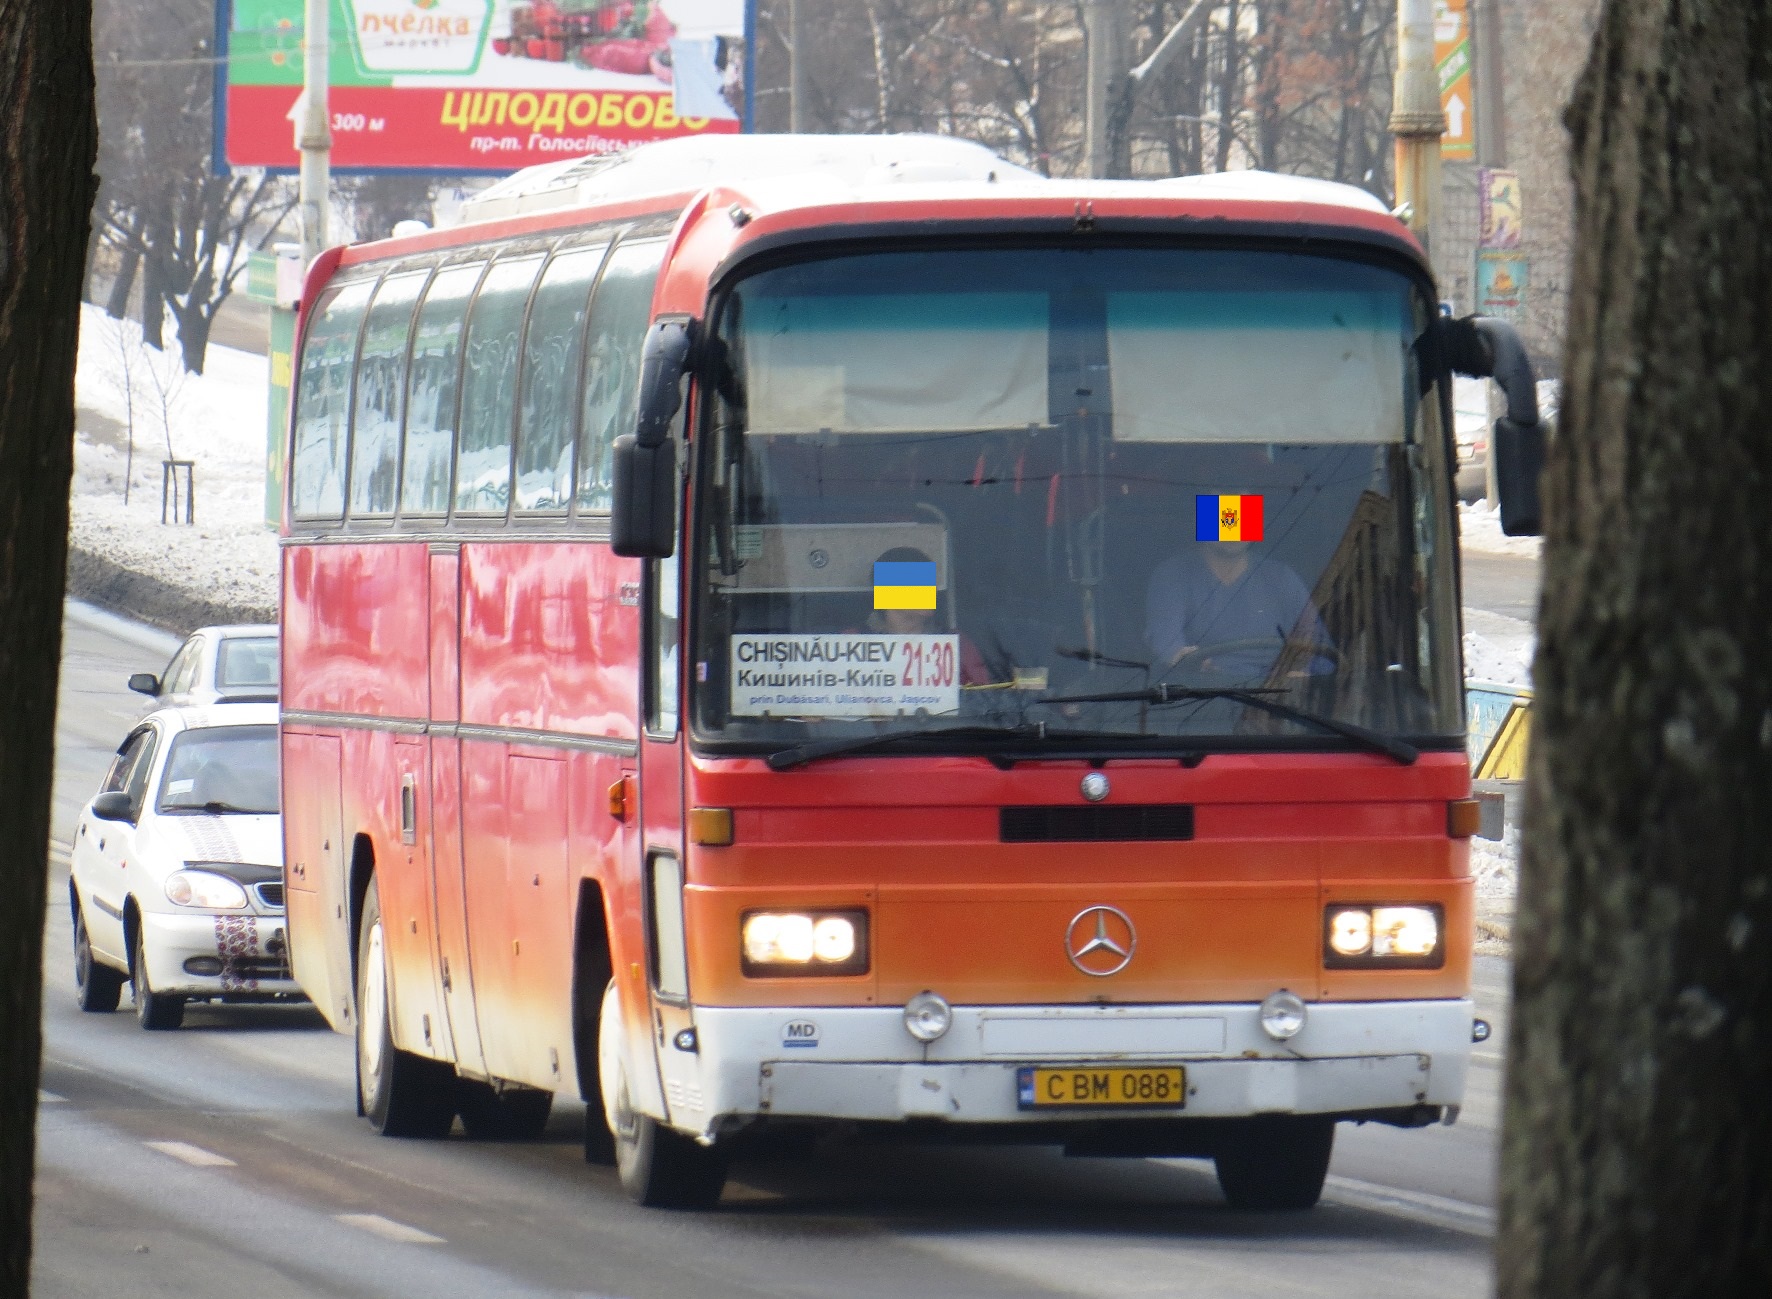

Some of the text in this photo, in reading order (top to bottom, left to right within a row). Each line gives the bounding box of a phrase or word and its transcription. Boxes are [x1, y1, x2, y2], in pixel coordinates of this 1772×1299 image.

[331, 112, 365, 131] 300
[902, 641, 954, 687] 21:30
[738, 669, 897, 687] Кишинів-Київ
[788, 1024, 815, 1037] MD
[1048, 1073, 1170, 1100] C BM 088
